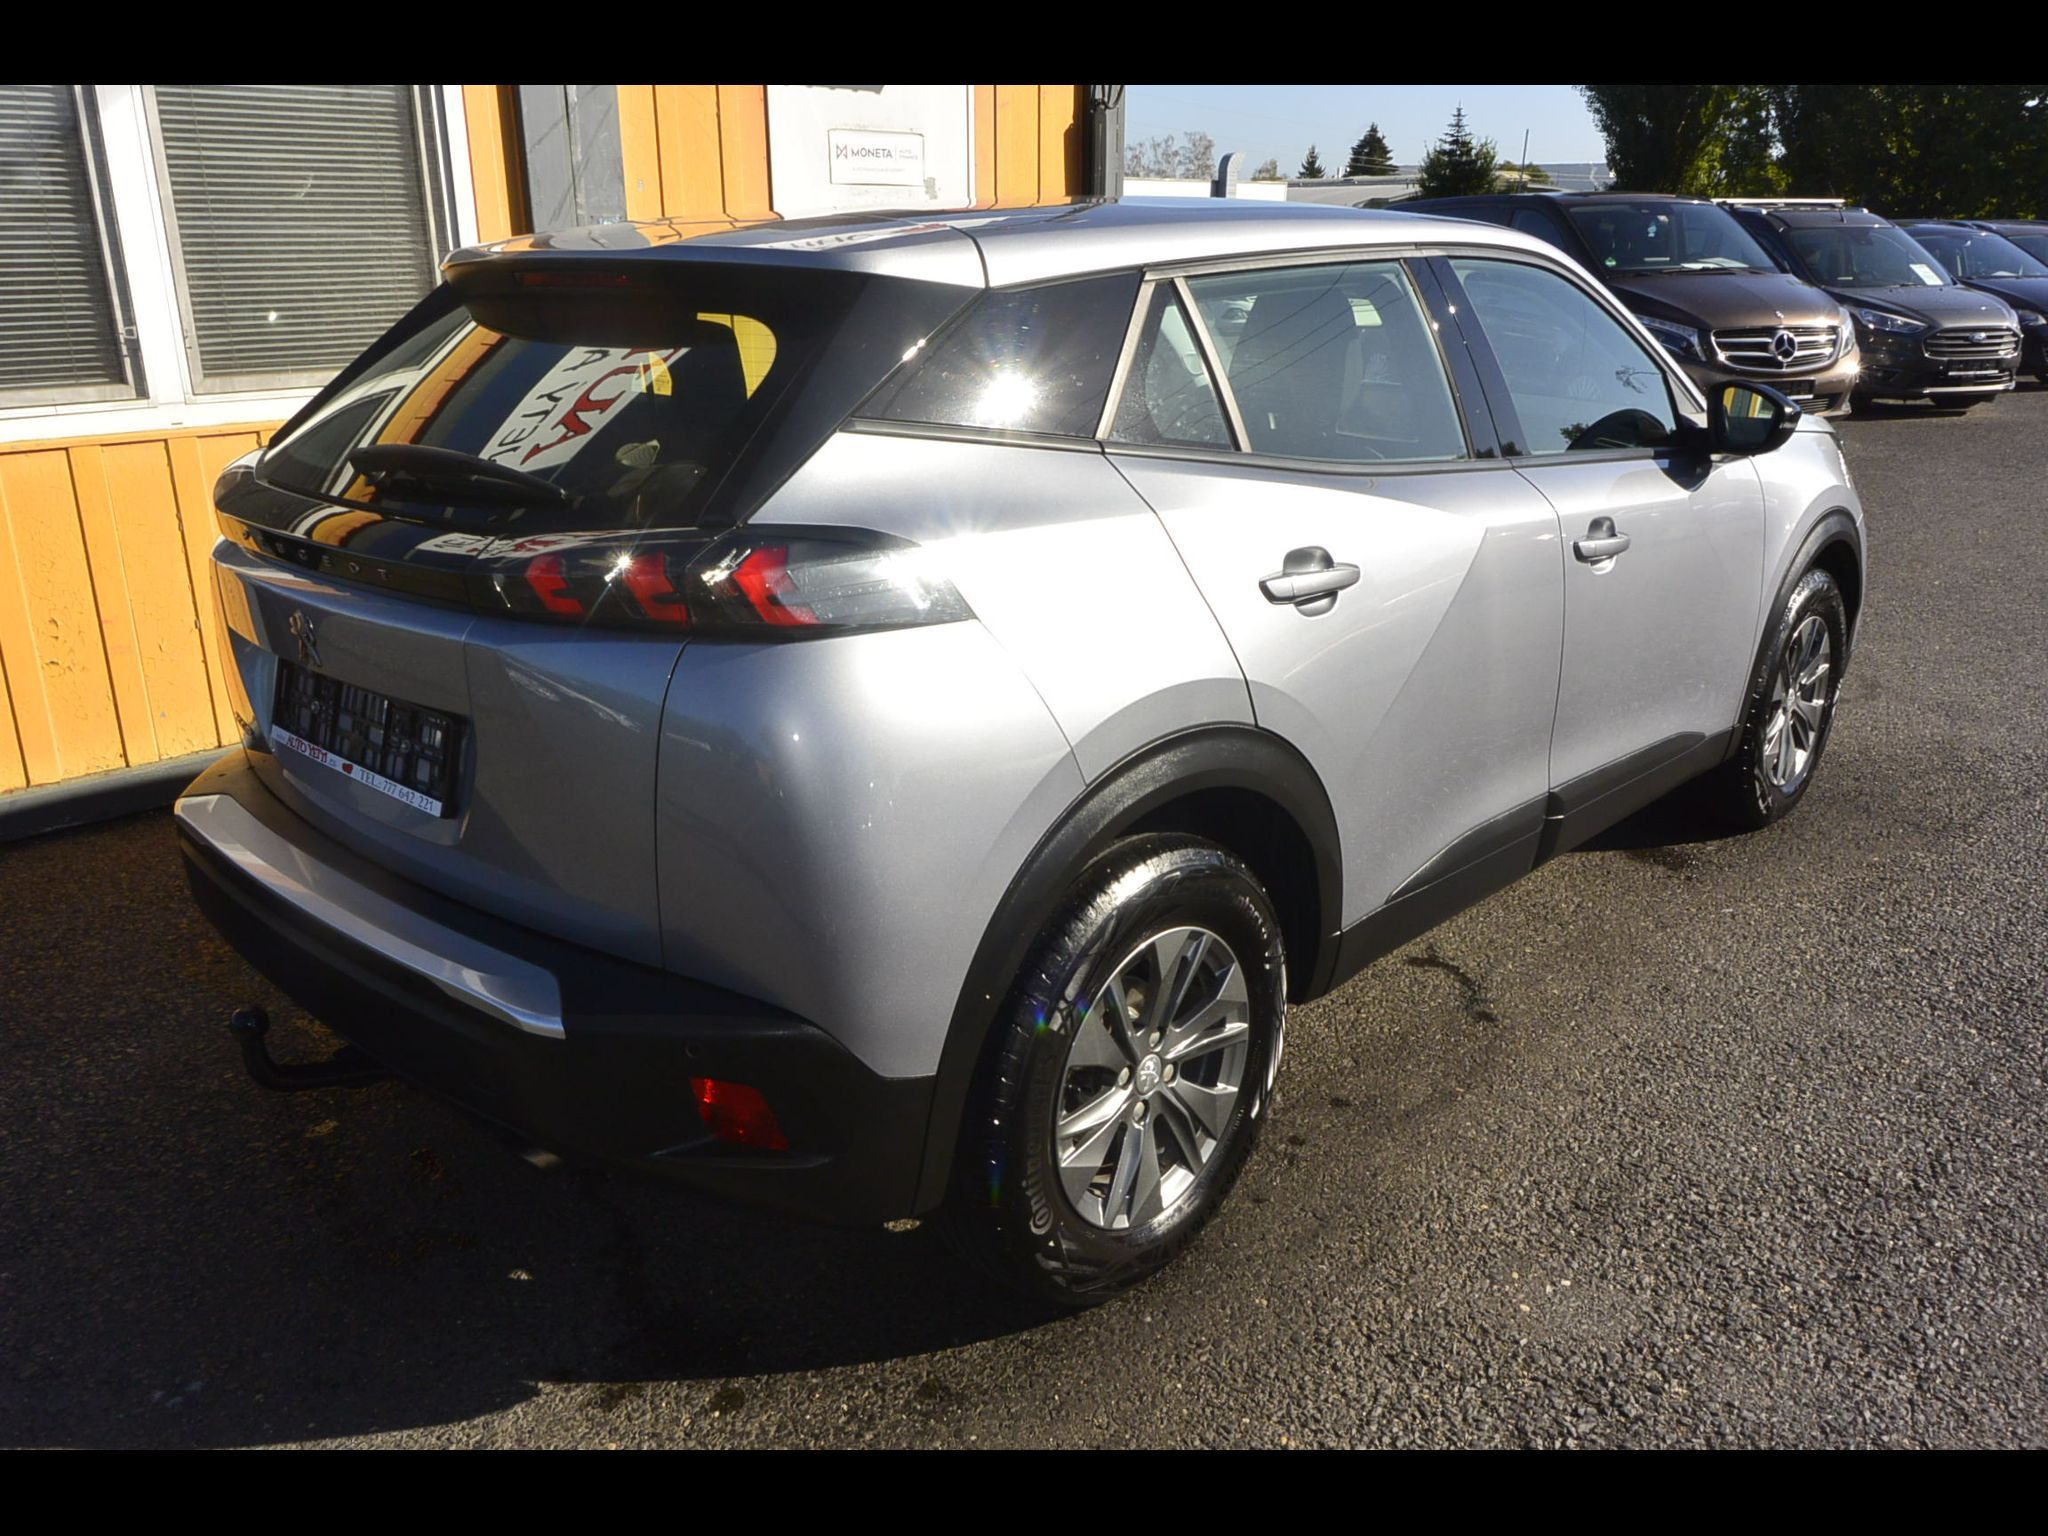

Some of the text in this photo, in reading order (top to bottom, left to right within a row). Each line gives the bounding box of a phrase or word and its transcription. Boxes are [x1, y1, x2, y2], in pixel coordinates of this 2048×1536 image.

[850, 147, 893, 159] MONETA
[286, 734, 308, 754] AUTO
[382, 780, 397, 796] 777
[398, 787, 416, 804] 642
[417, 795, 434, 812] 221
